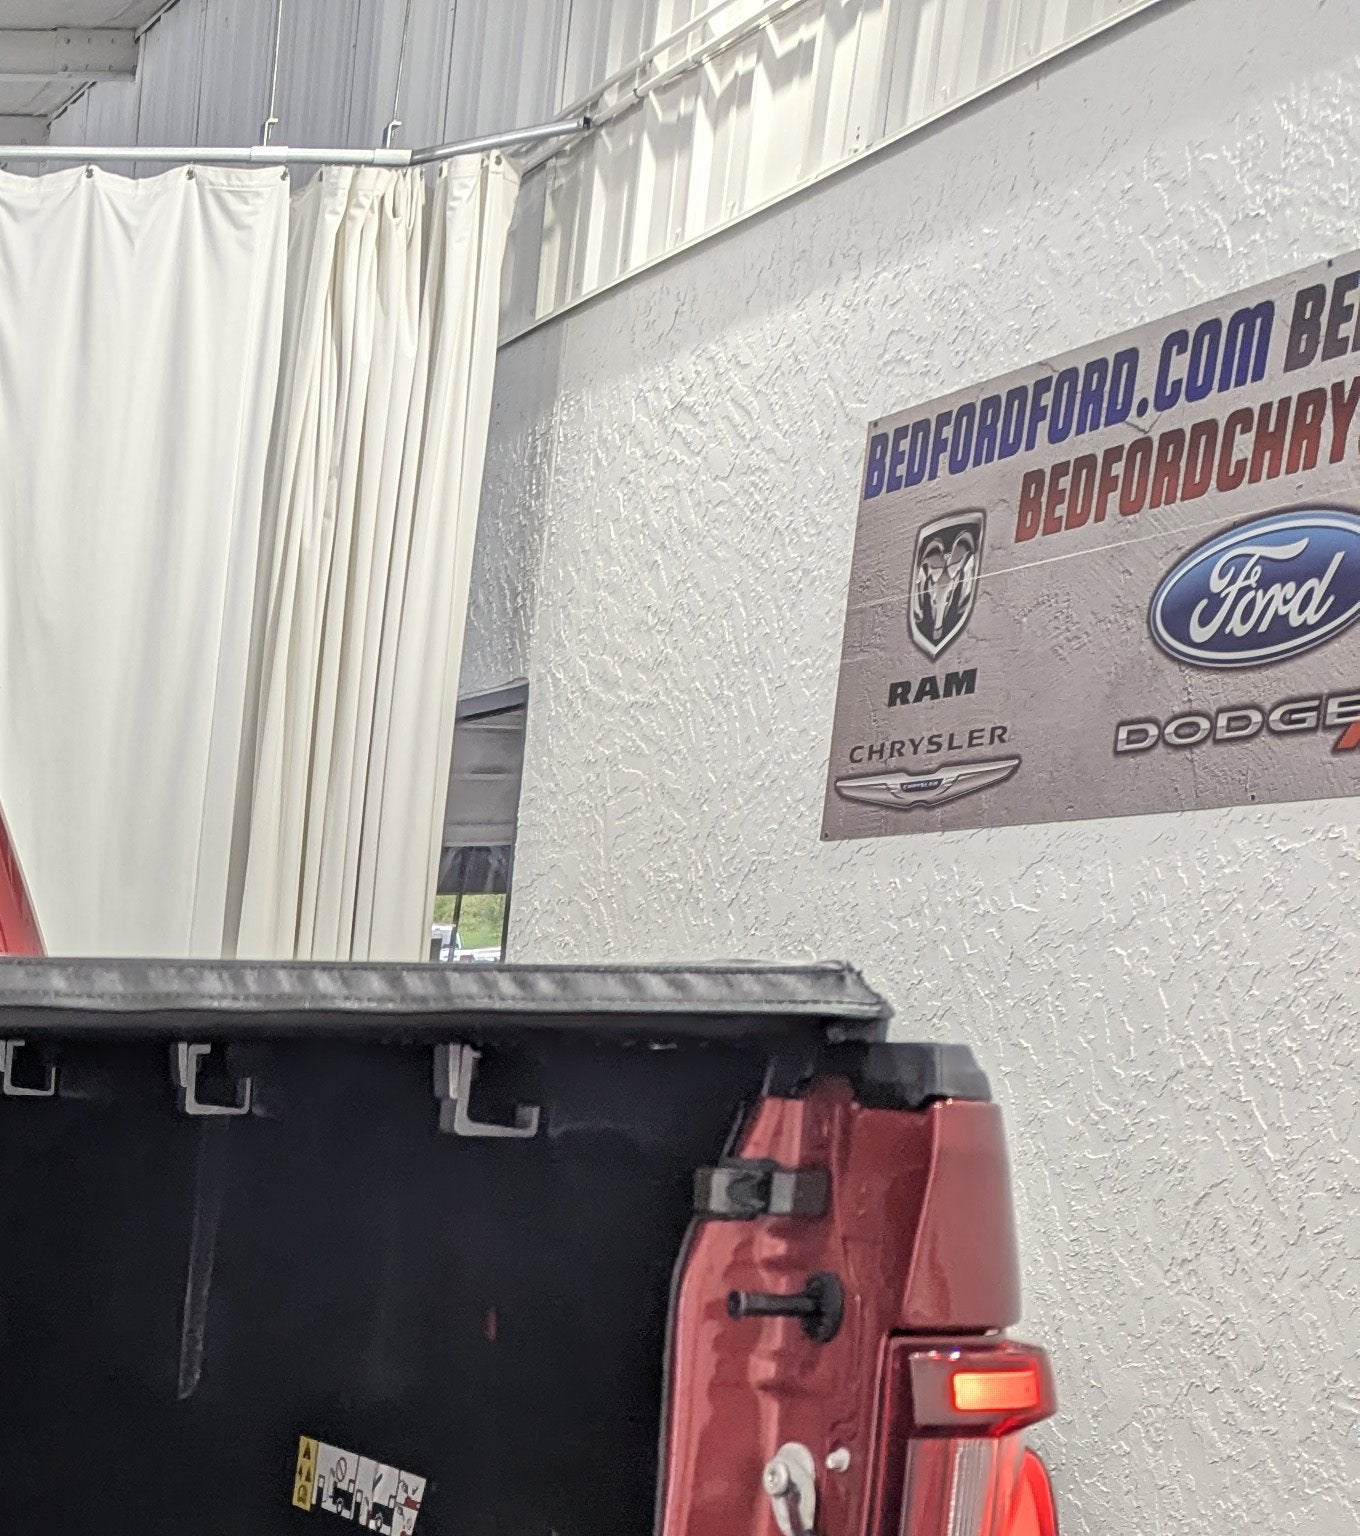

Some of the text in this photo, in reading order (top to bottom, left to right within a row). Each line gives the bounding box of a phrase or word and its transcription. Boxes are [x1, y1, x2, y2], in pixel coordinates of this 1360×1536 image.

[863, 271, 1360, 500] BEDFORDFORD.COM BE
[1014, 376, 1360, 543] BEDFORDCHRY
[1189, 537, 1346, 643] Ford
[888, 668, 978, 707] RAM
[1115, 692, 1360, 754] DODGE
[849, 725, 1008, 763] CHRYSLER
